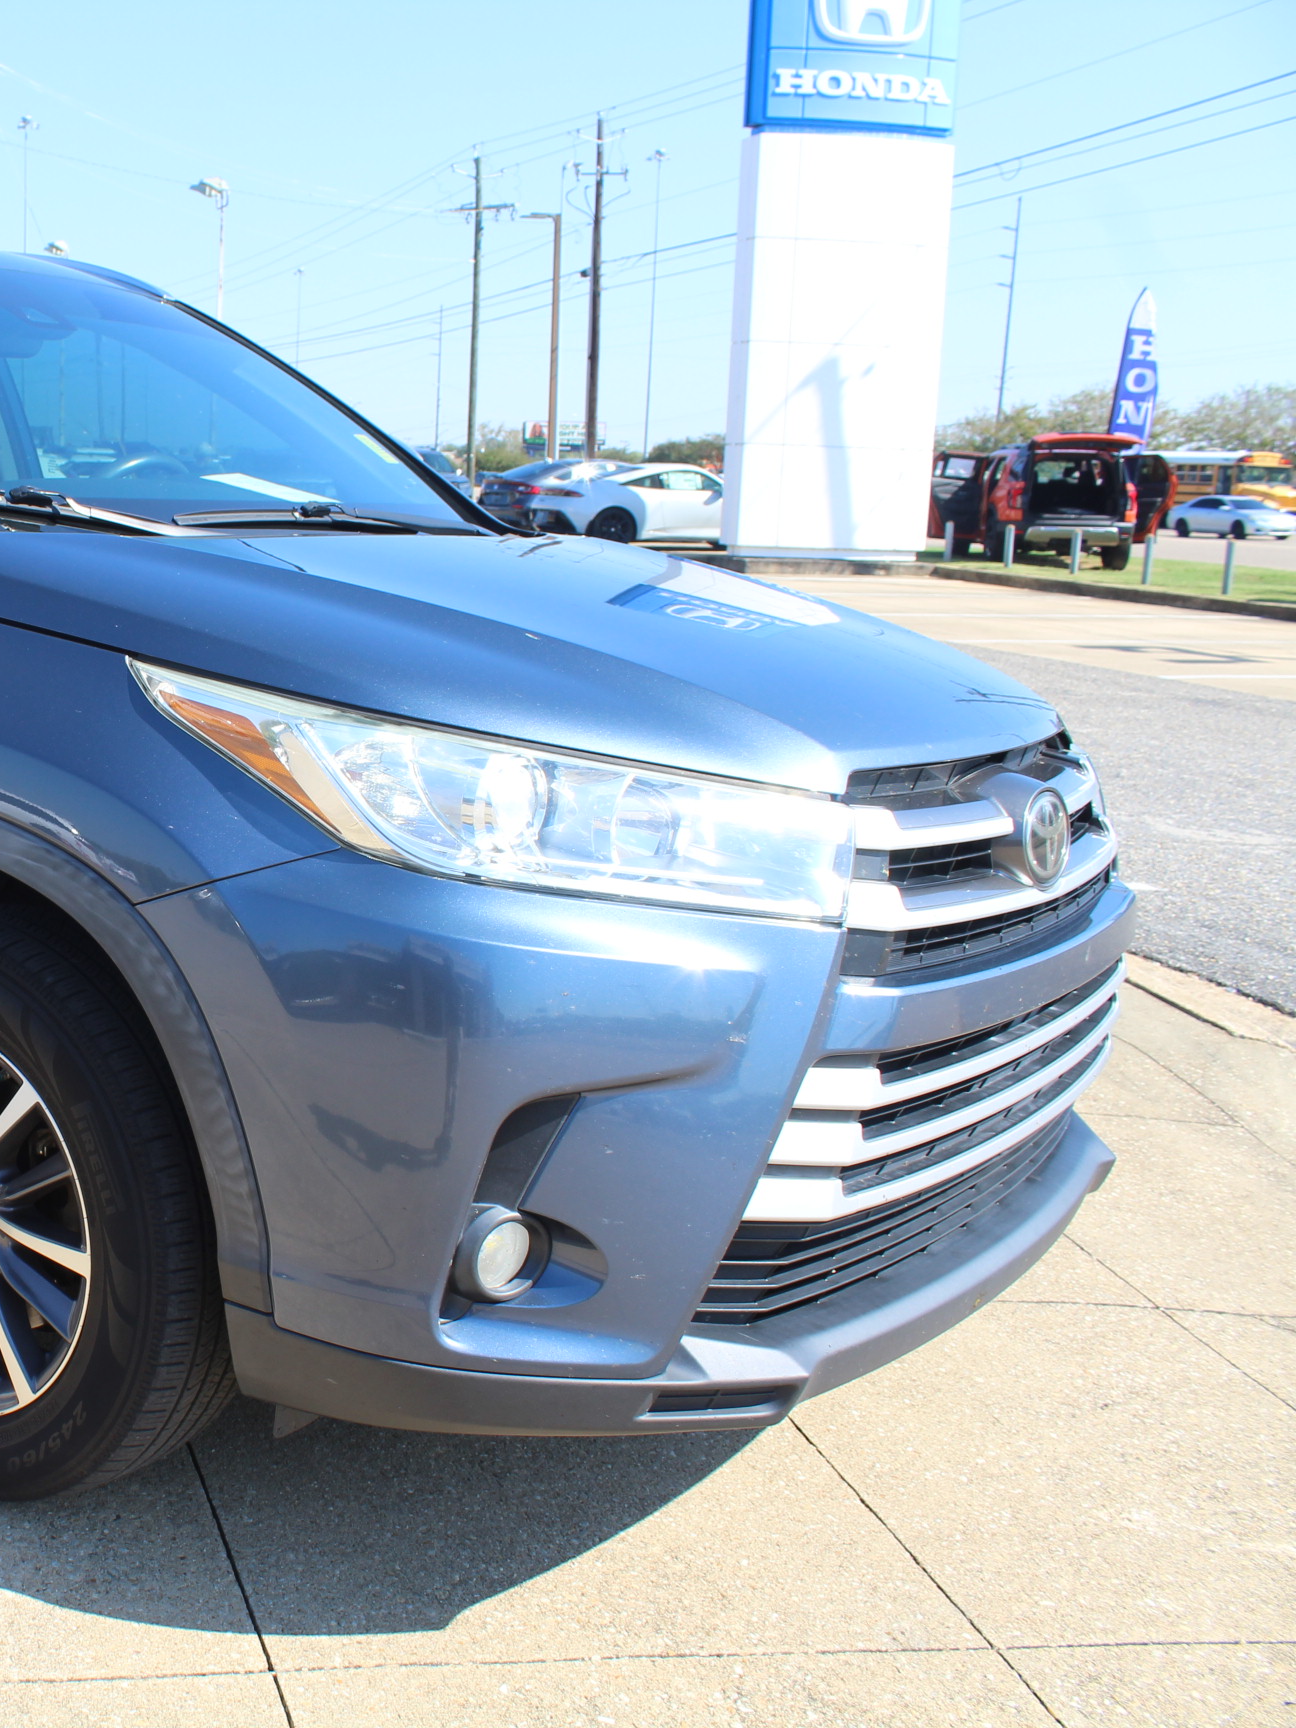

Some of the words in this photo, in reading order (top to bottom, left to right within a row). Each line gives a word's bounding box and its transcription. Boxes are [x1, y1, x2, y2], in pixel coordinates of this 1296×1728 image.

[774, 67, 952, 106] HONDA
[70, 1100, 126, 1215] PIRELLI
[6, 1400, 87, 1474] 245/60
